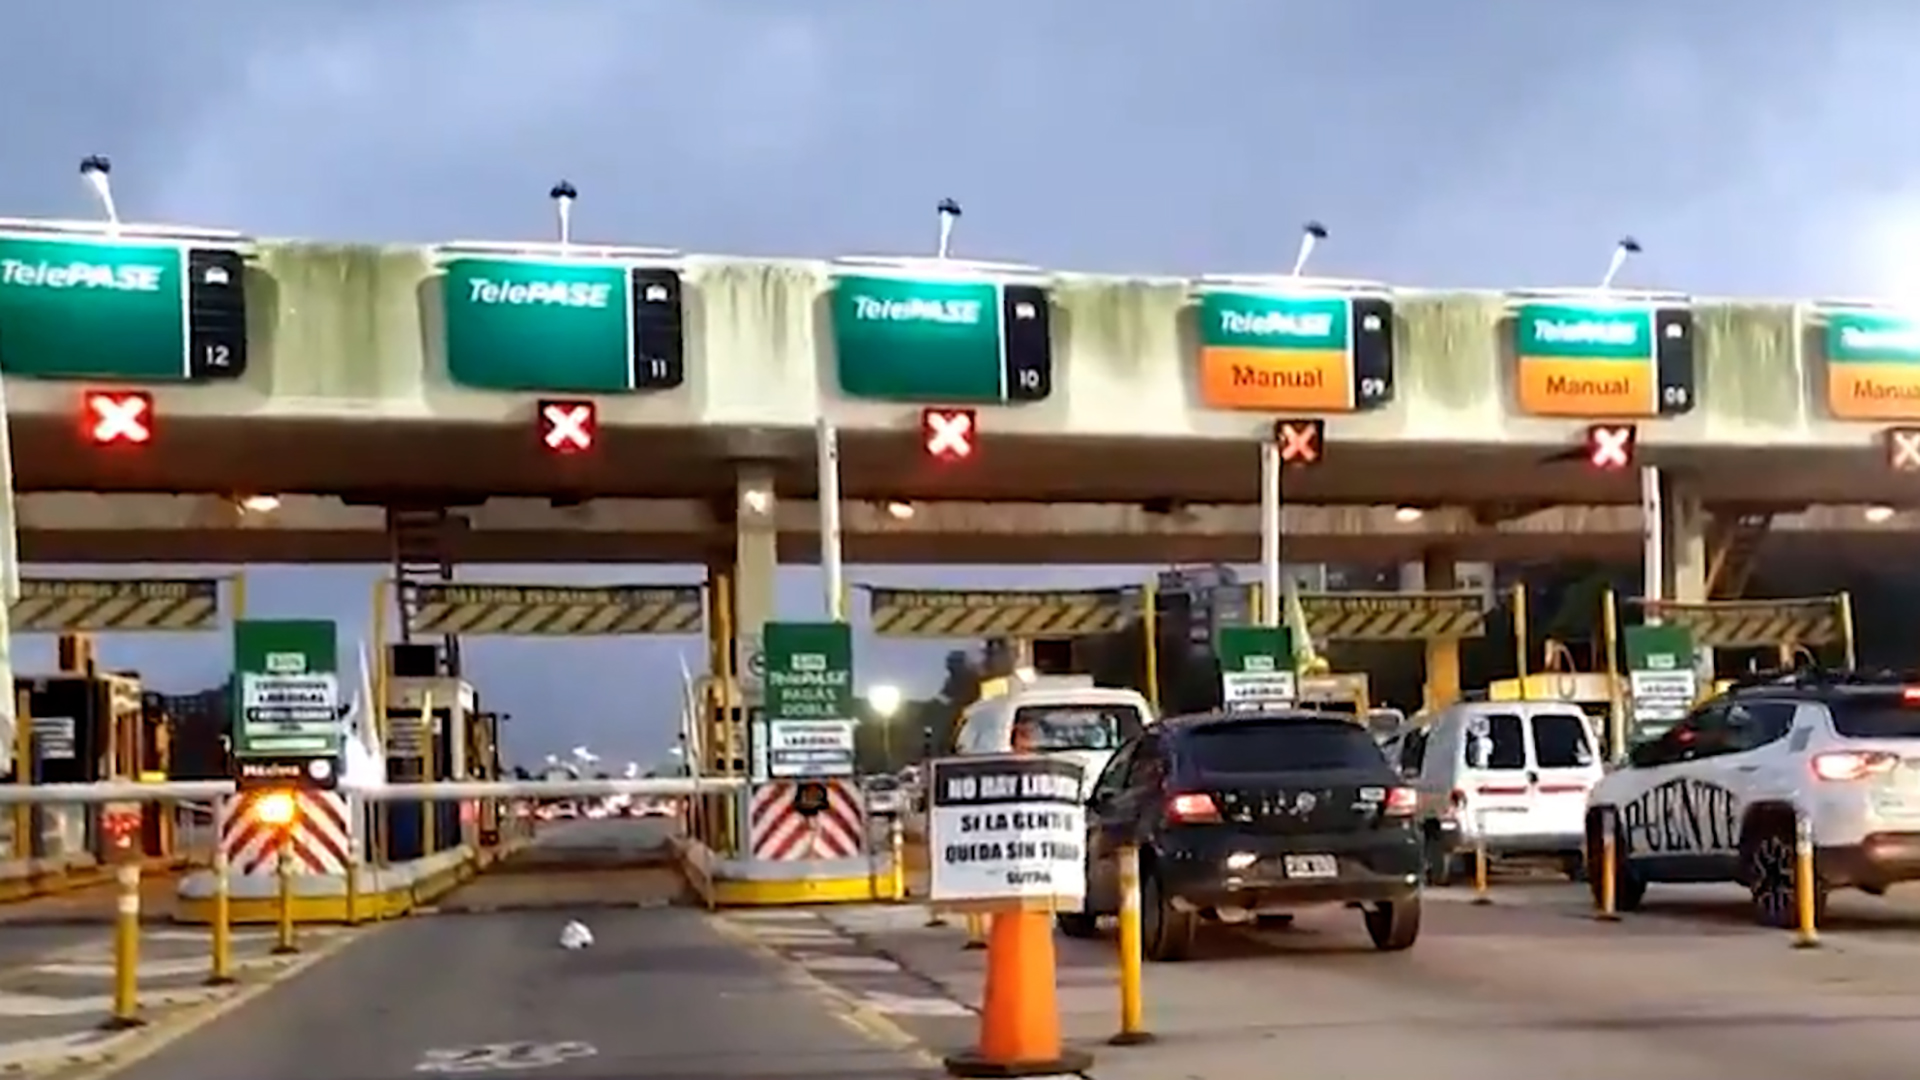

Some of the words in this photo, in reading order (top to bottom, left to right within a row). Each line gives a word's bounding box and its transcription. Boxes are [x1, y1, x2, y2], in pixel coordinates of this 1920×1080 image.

[2, 258, 164, 292] TelePASE
[468, 277, 612, 308] TelePASE
[853, 296, 981, 324] TelePASE
[205, 346, 229, 367] 12
[652, 359, 668, 378] 11
[1019, 369, 1040, 388] 10
[1231, 364, 1324, 389] Manual
[1545, 374, 1631, 396] Manual
[1852, 379, 1920, 400] Manua
[947, 776, 977, 800] NO
[980, 774, 1018, 799] HAY
[961, 815, 980, 832] SI
[985, 812, 1008, 832] LA
[1625, 776, 1740, 852] PUENTE
[945, 843, 1002, 864] QUEDA
[1006, 840, 1036, 860] SIN
